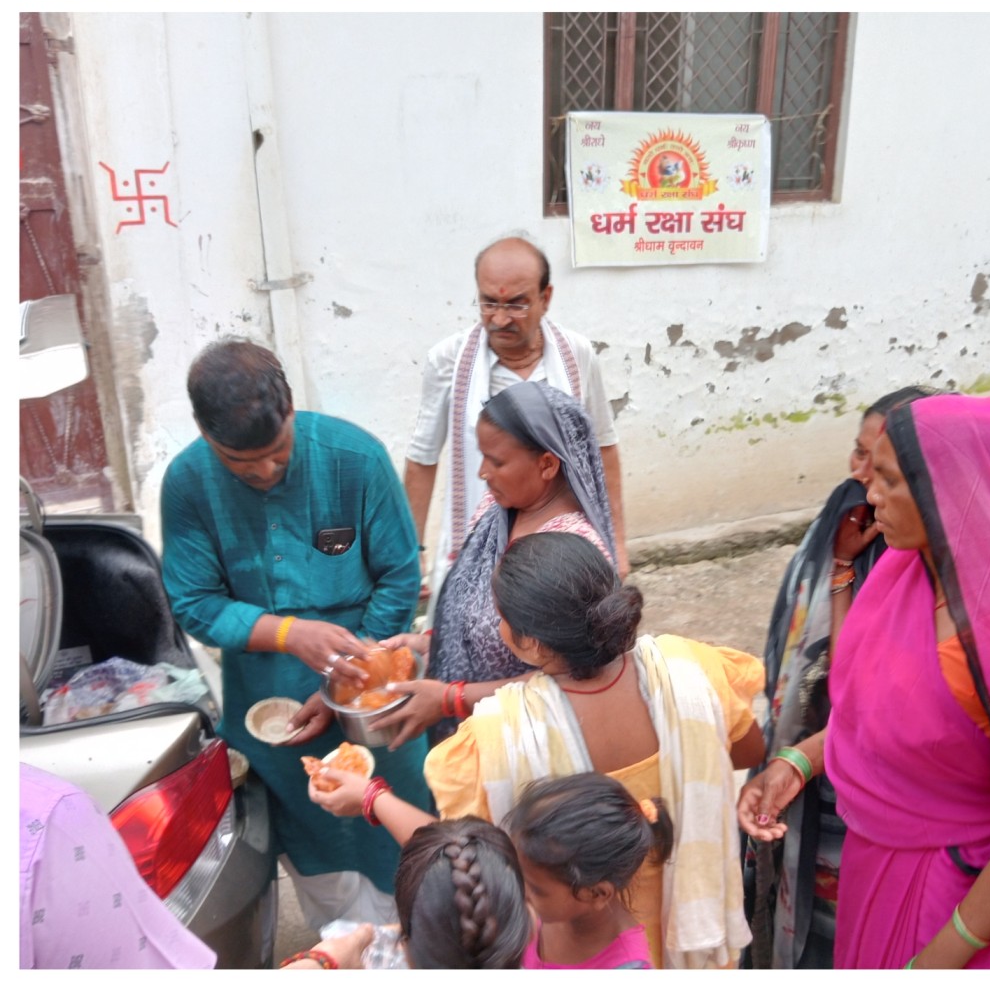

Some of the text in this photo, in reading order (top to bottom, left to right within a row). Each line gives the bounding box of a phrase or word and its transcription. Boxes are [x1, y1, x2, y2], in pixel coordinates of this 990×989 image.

[590, 202, 747, 235] धर्म रक्षा संघ
[634, 237, 705, 255] श्रीधाम वृन्दावन
